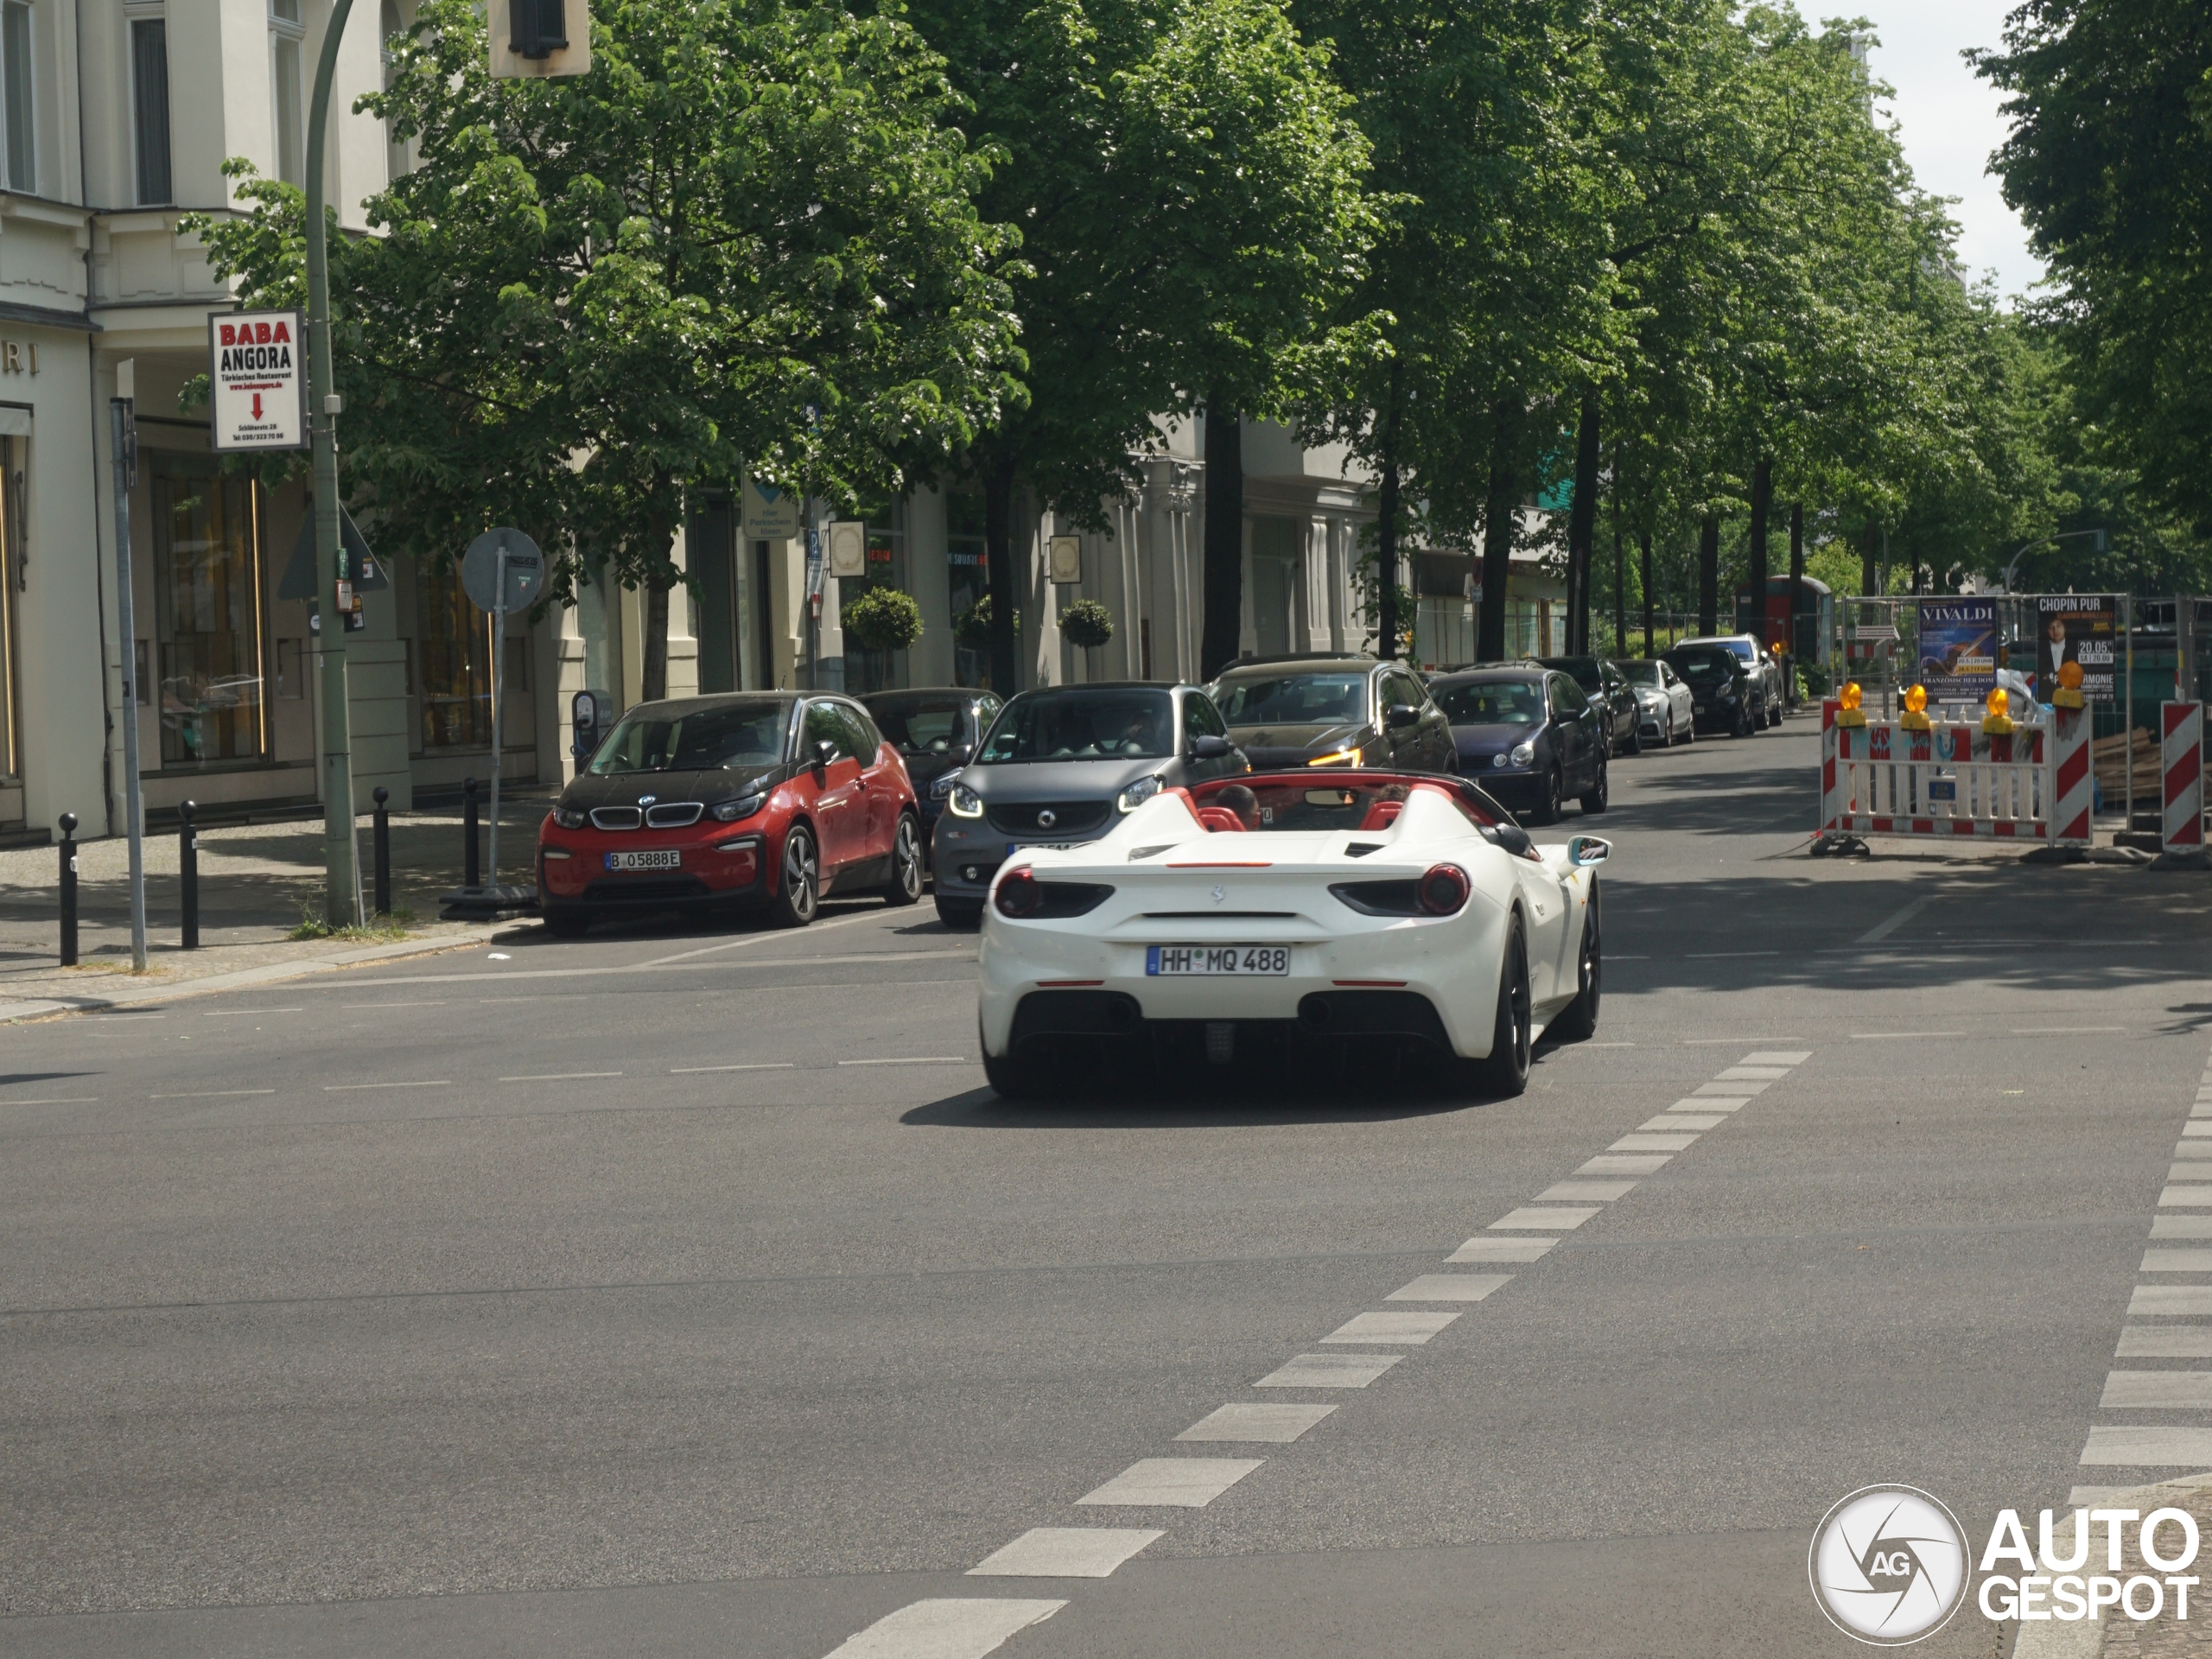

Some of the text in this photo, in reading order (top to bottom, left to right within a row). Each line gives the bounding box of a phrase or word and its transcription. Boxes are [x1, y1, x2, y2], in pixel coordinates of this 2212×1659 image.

[219, 321, 290, 346] BABA
[221, 346, 291, 372] ANGORA
[257, 372, 291, 380] Restaurant
[2039, 597, 2101, 612] CHOPIN PUR
[1923, 607, 1993, 621] VIVALDI
[1923, 676, 1978, 684] FRANZÖSISCHER
[611, 855, 620, 868] B
[1161, 950, 1286, 972] HH MQ 488
